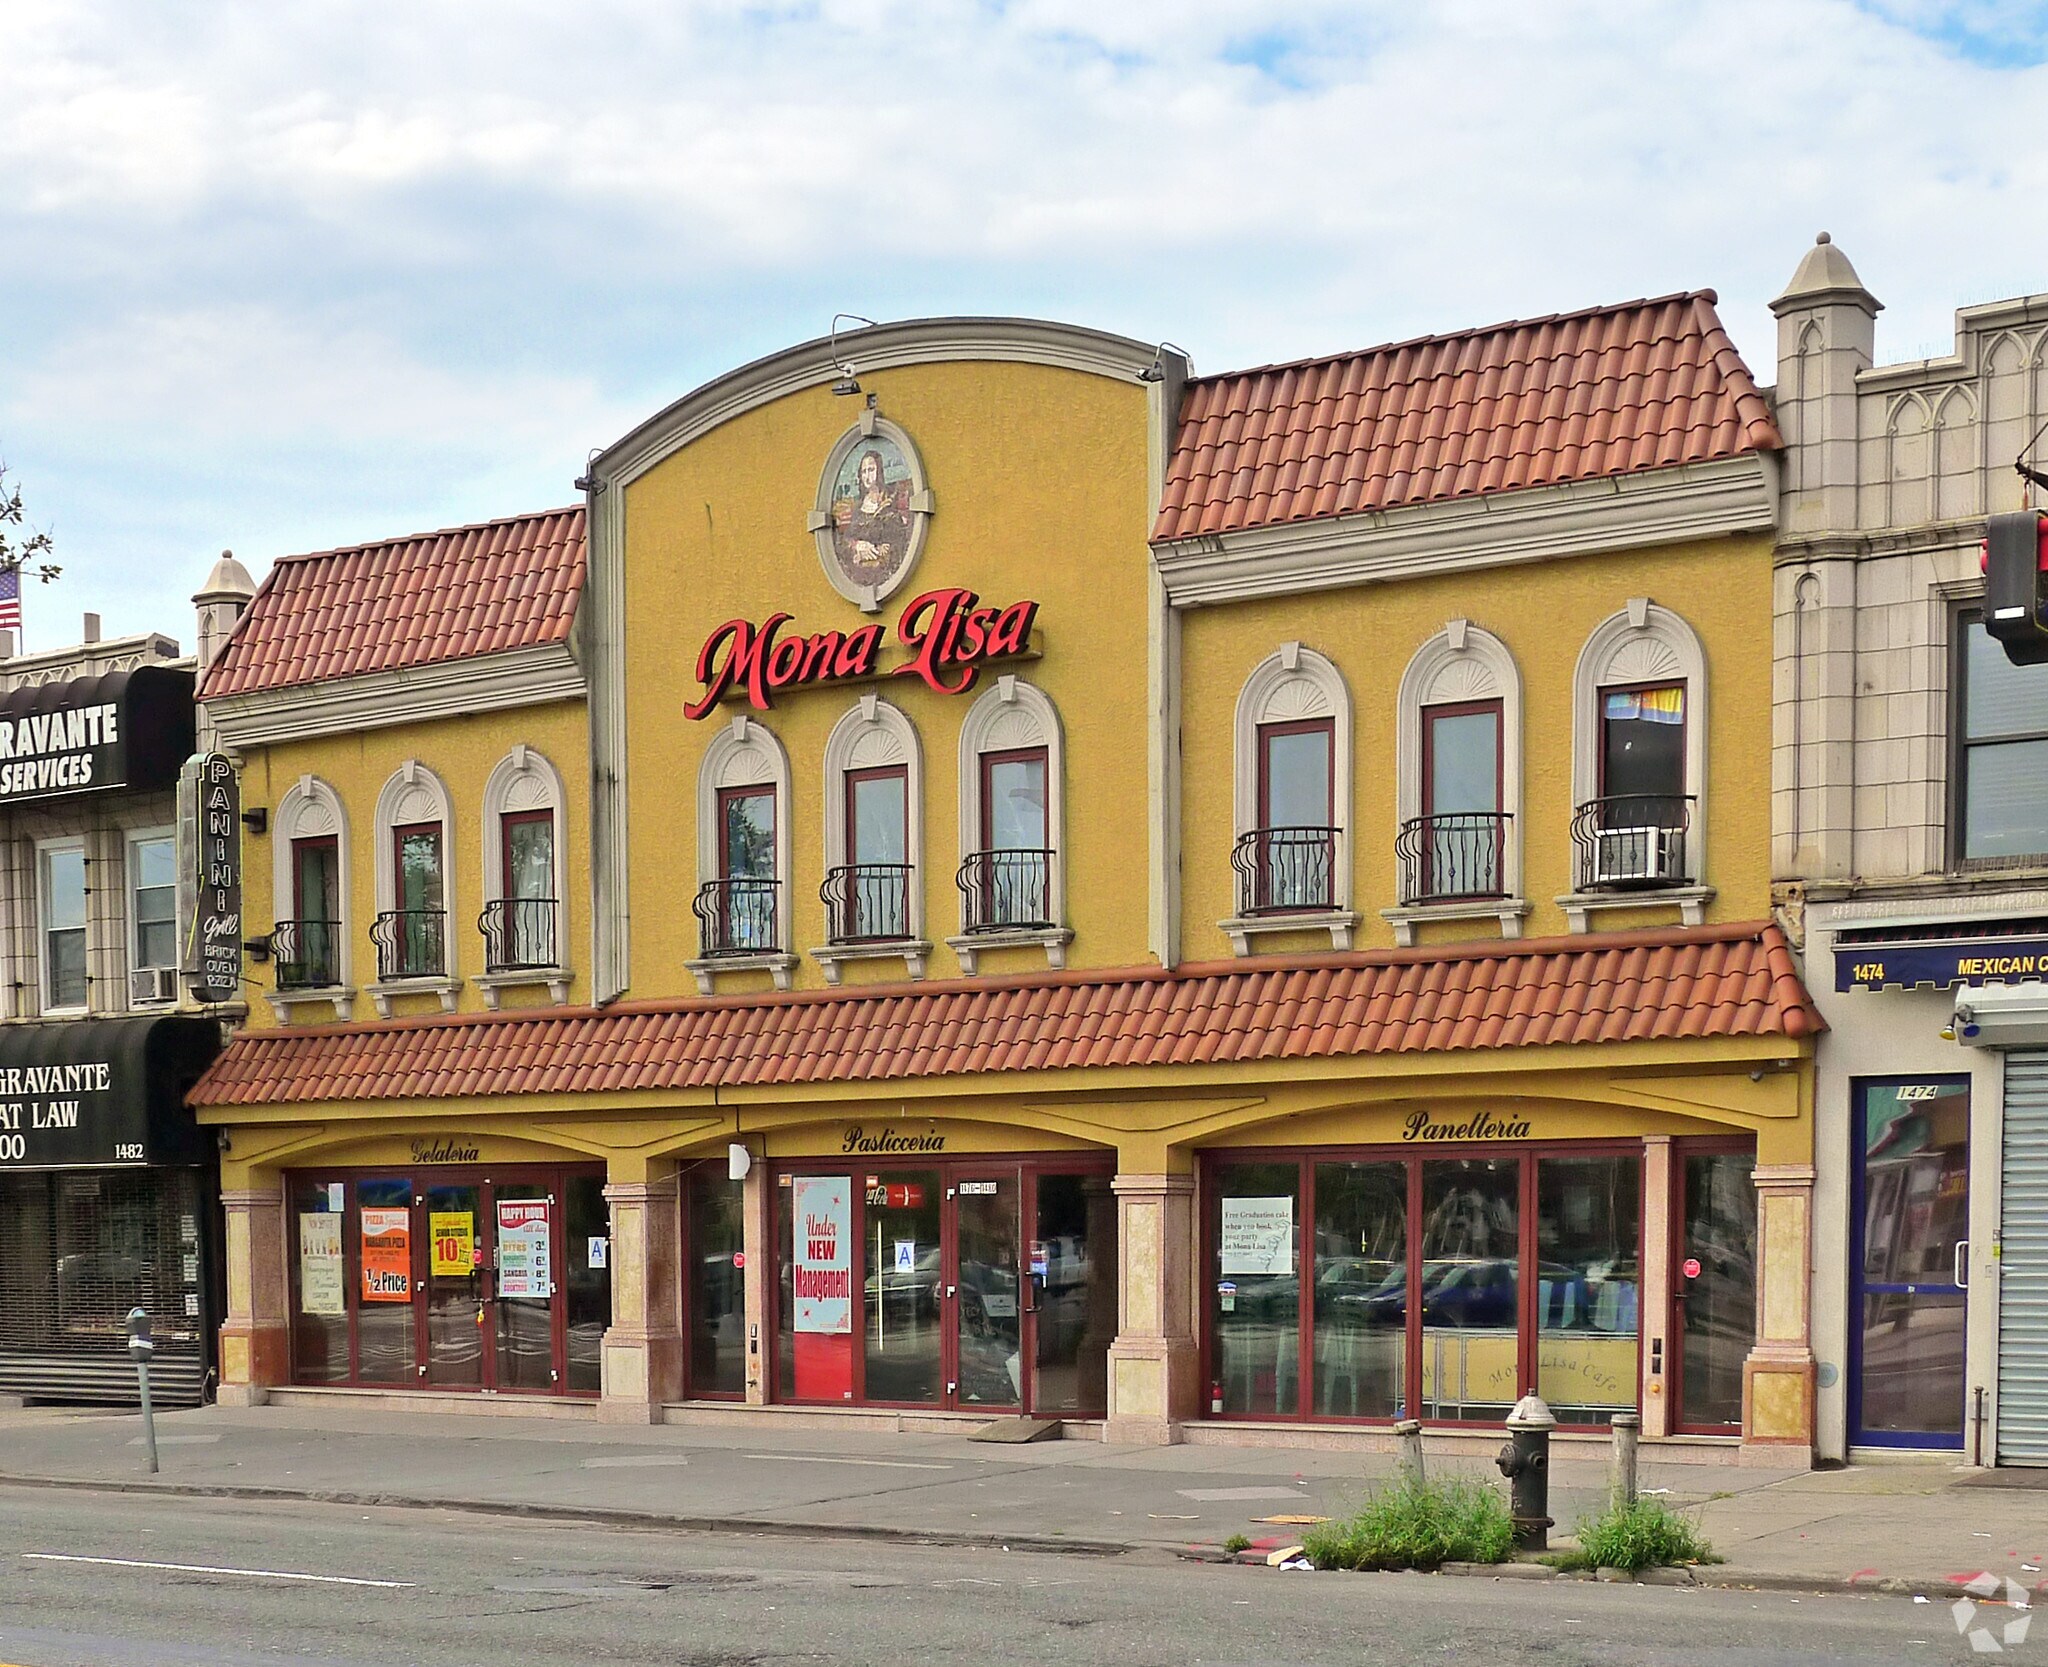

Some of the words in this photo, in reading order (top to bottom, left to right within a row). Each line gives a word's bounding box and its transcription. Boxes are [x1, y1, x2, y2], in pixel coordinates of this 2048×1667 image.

[684, 612, 887, 720] Mona
[892, 588, 1040, 695] Lisa
[0, 703, 118, 759] RAVANTE
[0, 753, 93, 794] SERVICES
[209, 760, 232, 912] PANINI
[203, 914, 238, 944] Grill
[204, 944, 237, 959] BRICK
[206, 960, 238, 974] OVEN
[1853, 963, 1884, 980] 1474
[1958, 956, 2034, 975] MEXICAN
[1900, 1087, 1936, 1098] 1474
[0, 1103, 23, 1129] AT
[31, 1101, 79, 1128] LAW
[1403, 1110, 1531, 1140] Panetteria
[842, 1126, 945, 1152] Pasticceria
[114, 1143, 143, 1159] 1482
[411, 1139, 479, 1162] Gelateria
[365, 1214, 384, 1225] PIZZA
[501, 1207, 523, 1219] HAPPY
[525, 1207, 545, 1219] HOUR
[806, 1214, 836, 1236] Under
[435, 1238, 458, 1261] 10
[592, 1241, 602, 1257] A
[808, 1240, 835, 1260] NEW
[899, 1247, 911, 1264] A
[382, 1271, 407, 1292] Price
[796, 1265, 850, 1302] Management
[1489, 1364, 1518, 1388] Mo
